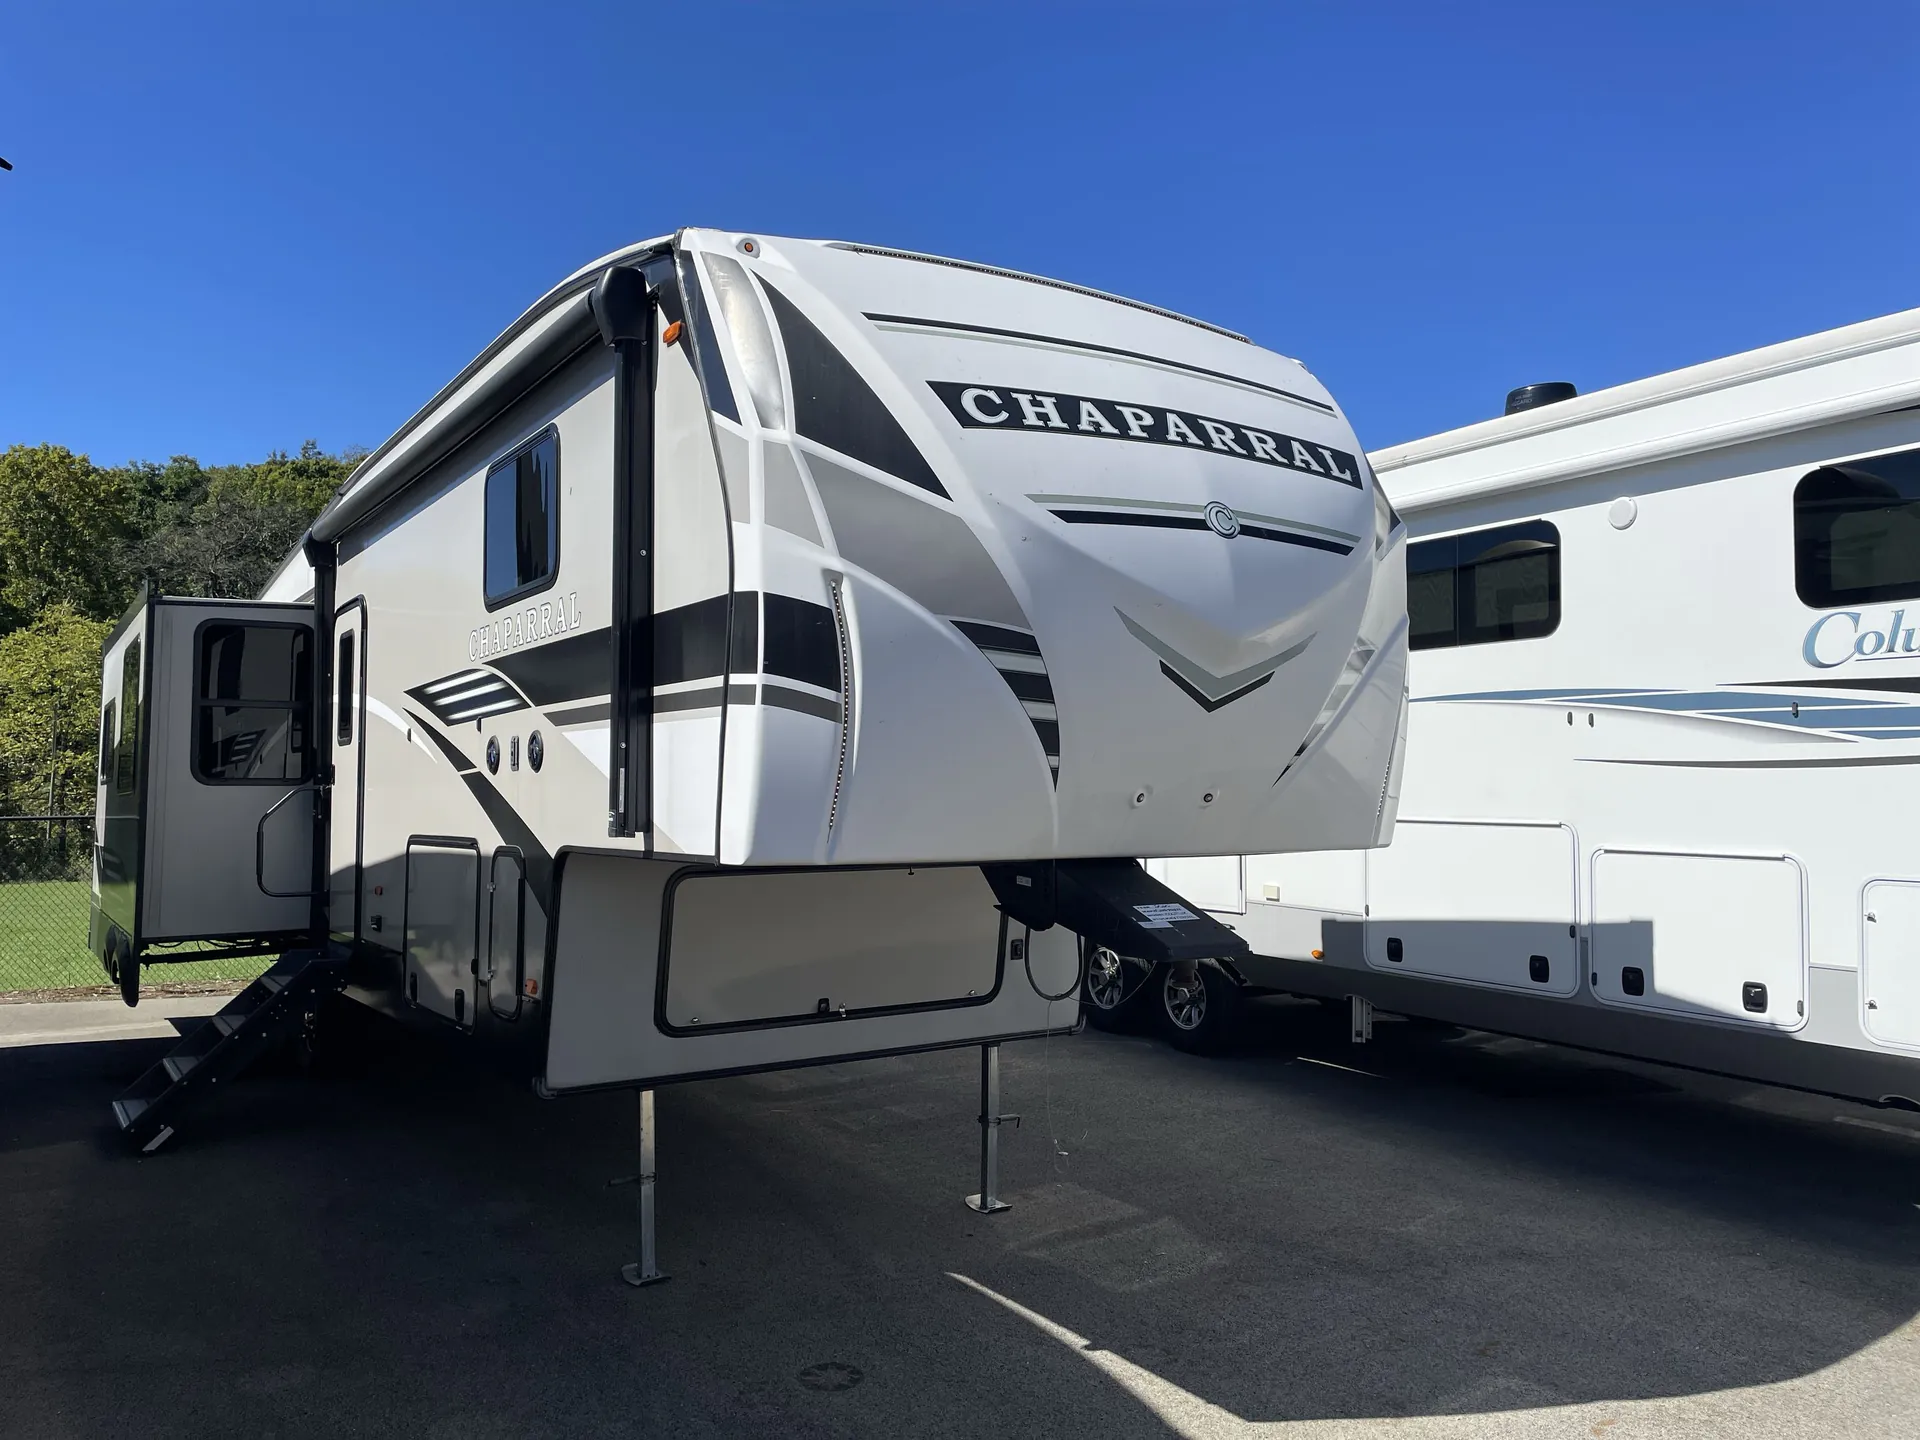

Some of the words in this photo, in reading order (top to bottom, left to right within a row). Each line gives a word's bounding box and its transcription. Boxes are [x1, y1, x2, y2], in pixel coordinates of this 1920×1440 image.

[960, 387, 1354, 483] CHAPARRAL
[1208, 505, 1237, 537] C
[469, 592, 582, 661] CHAPARRAL
